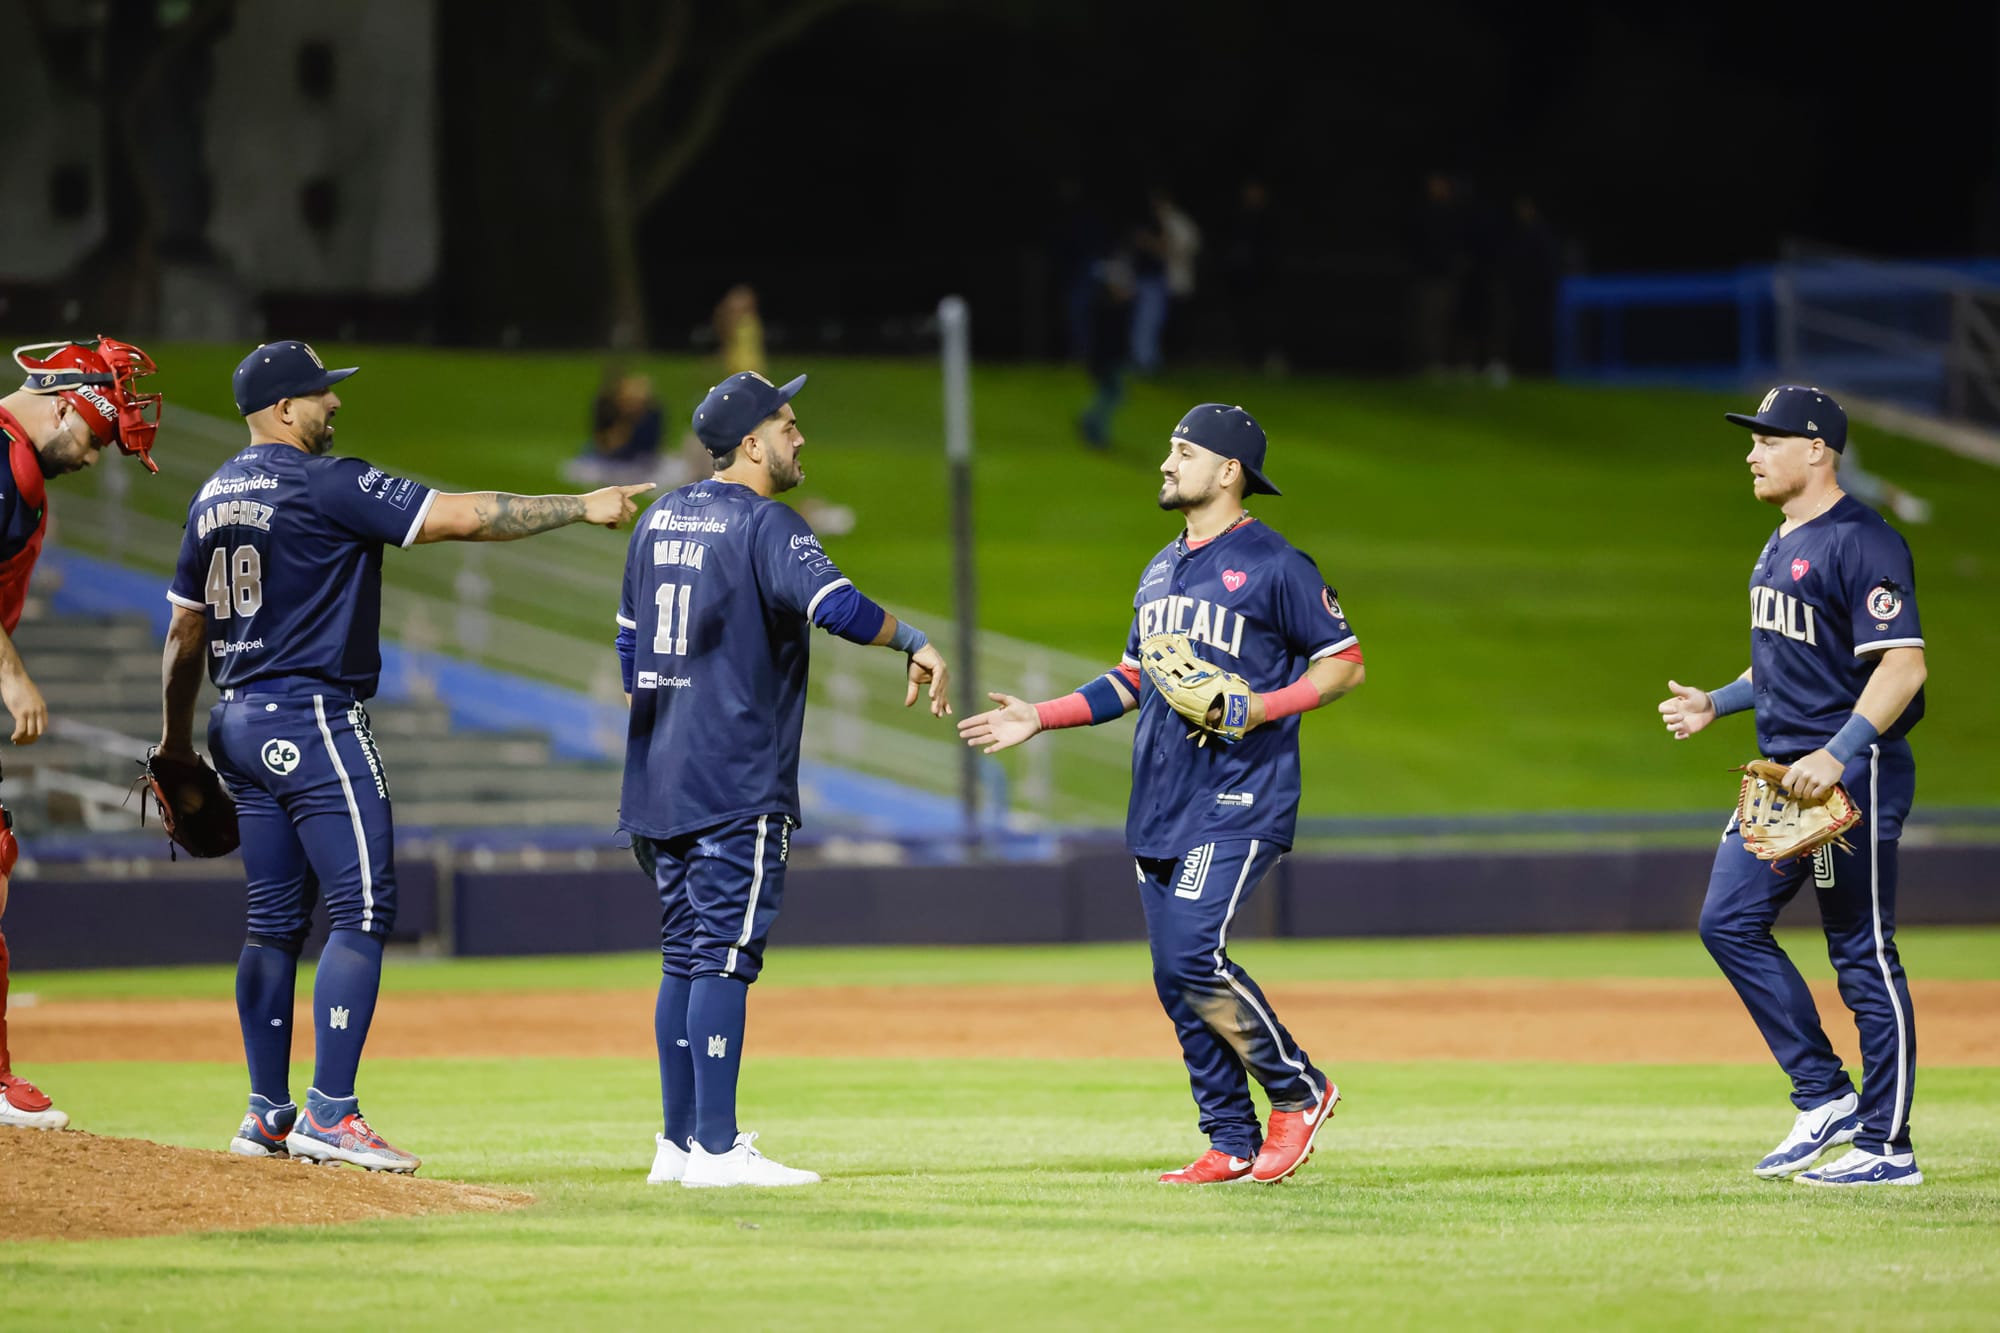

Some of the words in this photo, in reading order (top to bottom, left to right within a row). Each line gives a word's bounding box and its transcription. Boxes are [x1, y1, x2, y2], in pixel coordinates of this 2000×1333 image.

[214, 474, 278, 496] benavides
[197, 500, 274, 539] SANCHEZ
[654, 540, 704, 570] MEJIA
[204, 544, 263, 620] 48
[653, 583, 692, 656] 11
